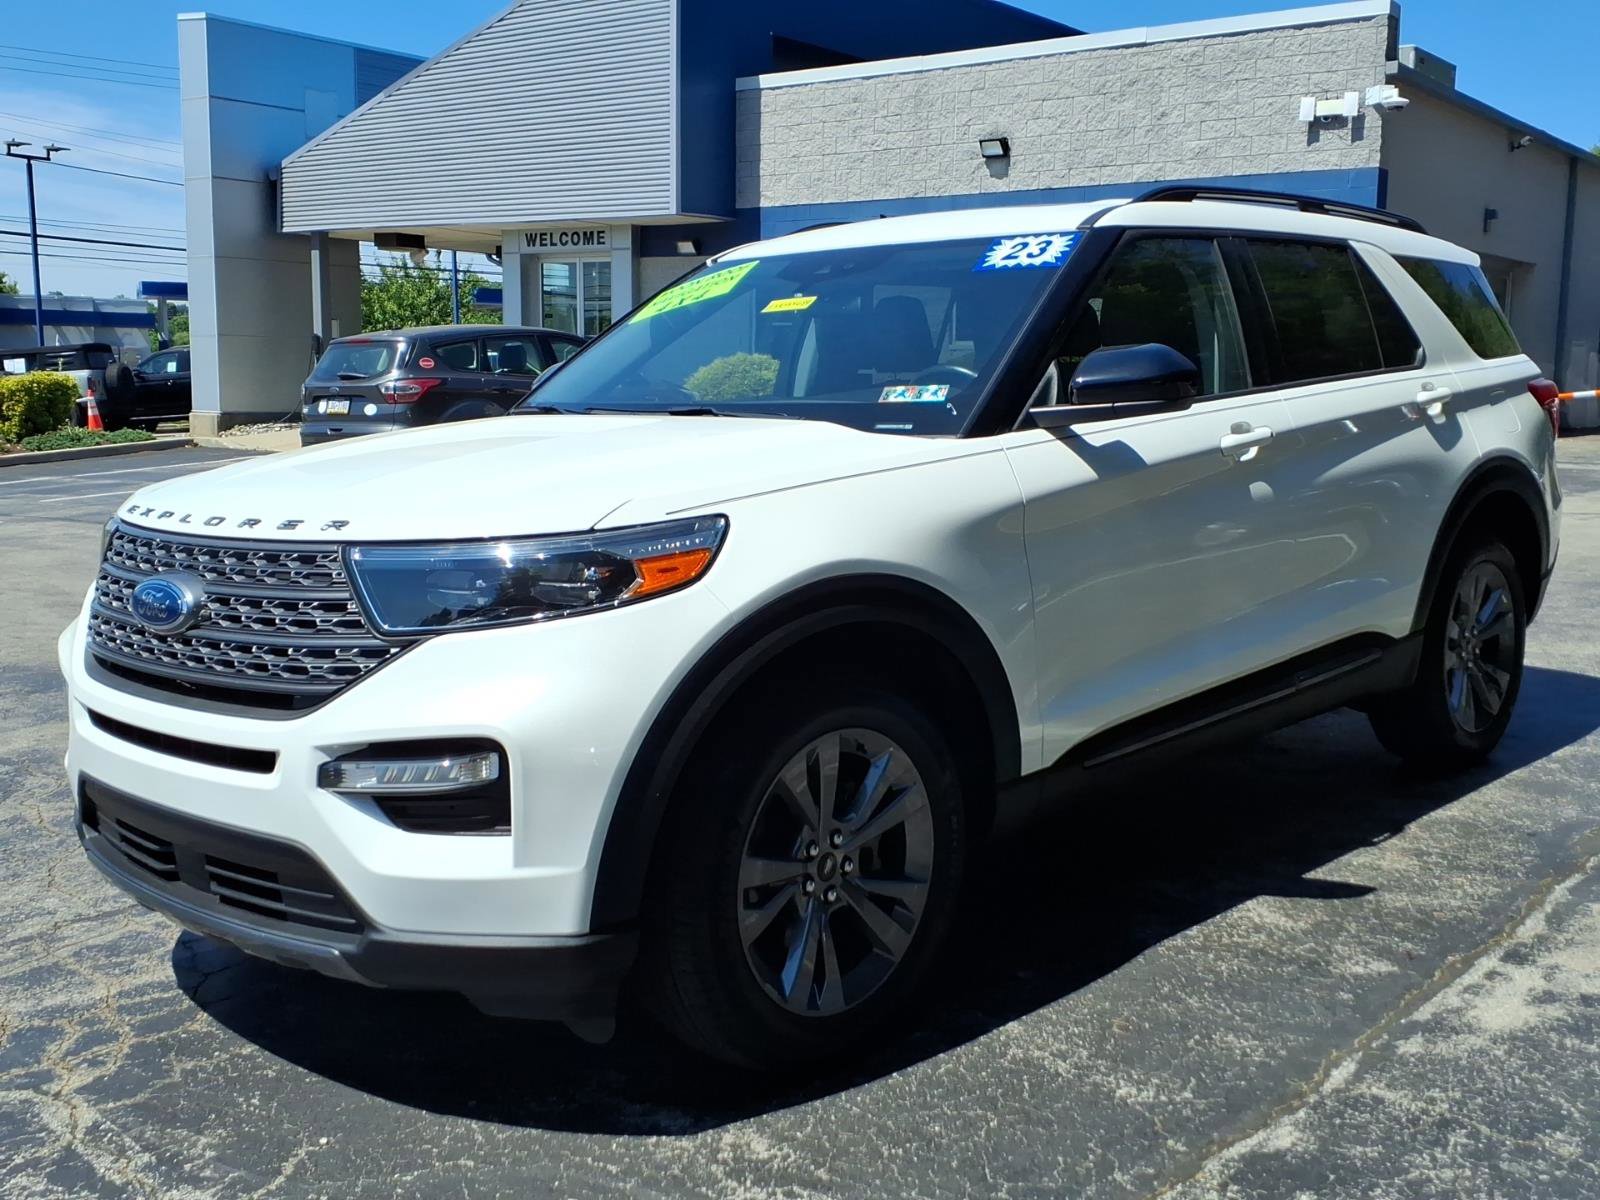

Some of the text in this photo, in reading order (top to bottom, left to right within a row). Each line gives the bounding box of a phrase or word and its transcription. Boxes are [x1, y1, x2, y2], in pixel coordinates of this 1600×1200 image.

[525, 230, 606, 247] WELCOME
[1000, 240, 1053, 260] 23
[127, 504, 350, 531] EXPLORER
